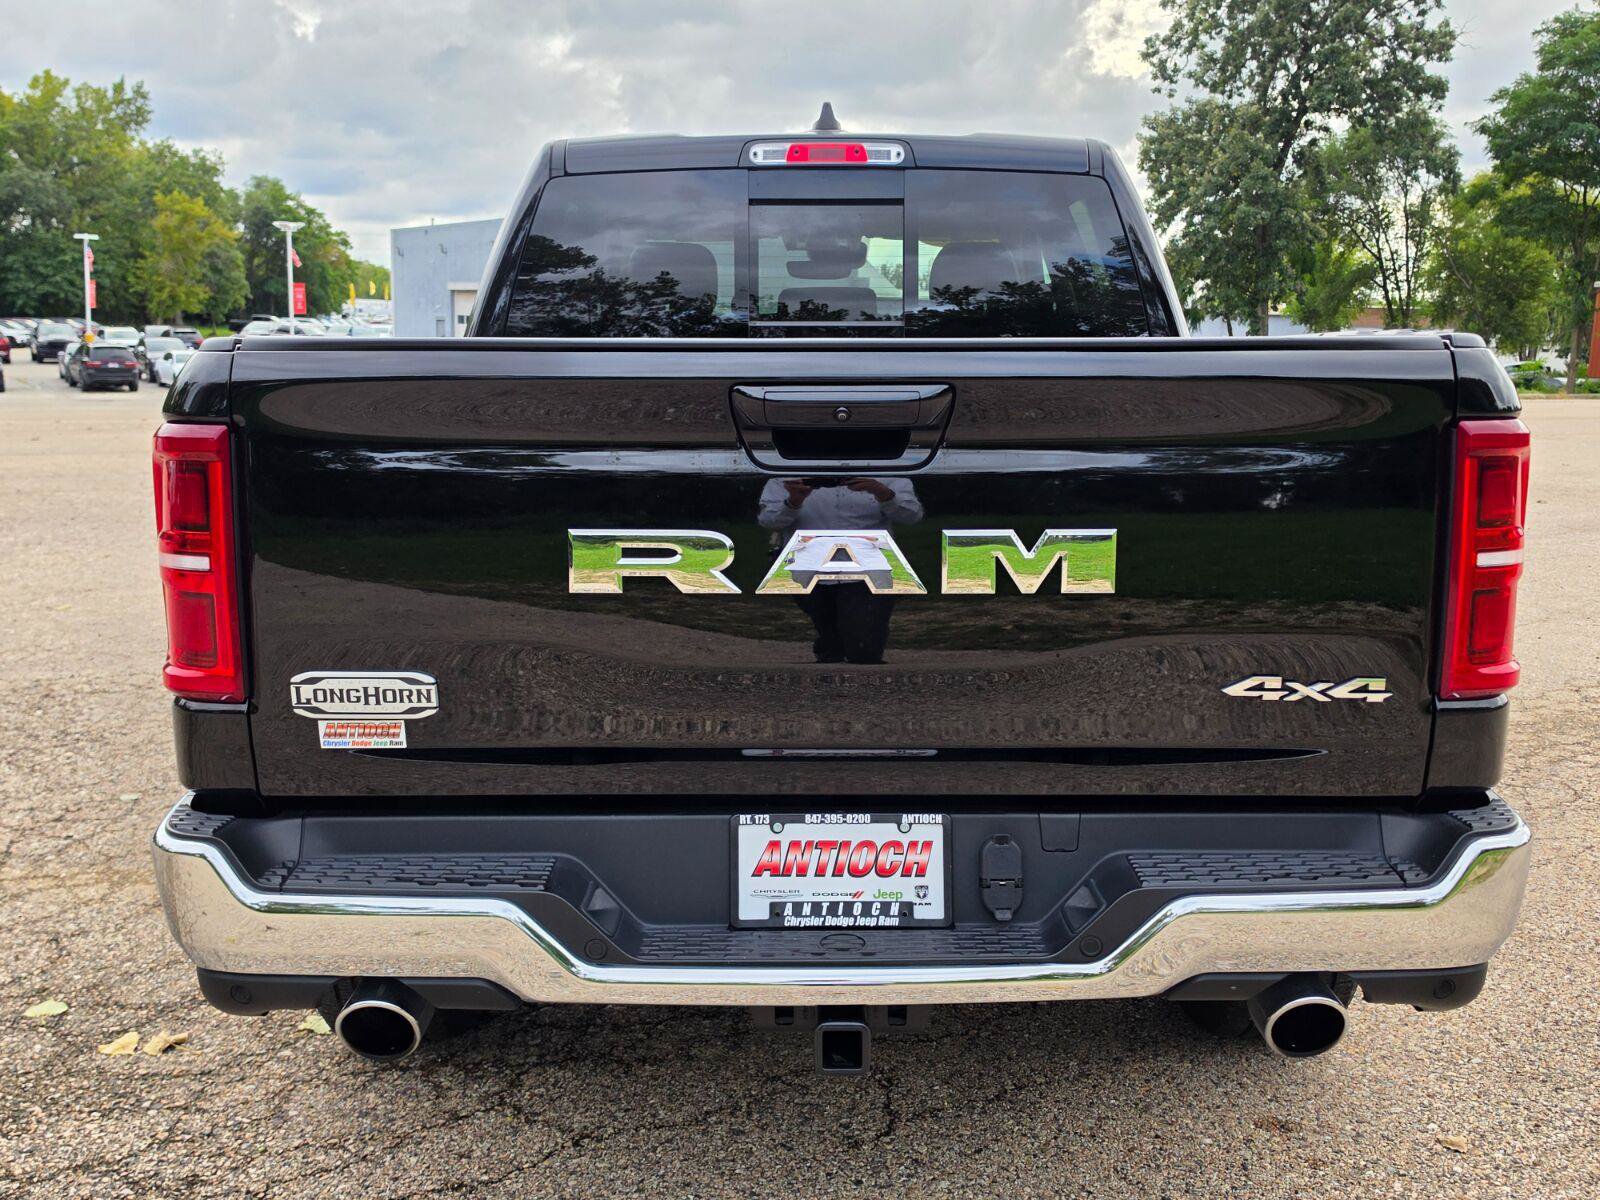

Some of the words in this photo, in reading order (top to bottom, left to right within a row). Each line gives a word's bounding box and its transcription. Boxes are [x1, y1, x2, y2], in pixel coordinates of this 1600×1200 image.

[567, 528, 1118, 595] RAM
[323, 722, 402, 739] ANTIOCH
[754, 814, 770, 825] 173
[901, 814, 943, 824] ANTIOCH
[751, 840, 934, 878] ANTIOCH
[873, 889, 903, 900] Jeep
[784, 916, 824, 927] Chrysler
[825, 916, 854, 927] Dodge
[855, 916, 877, 927] Jeep
[878, 916, 900, 926] Ram
